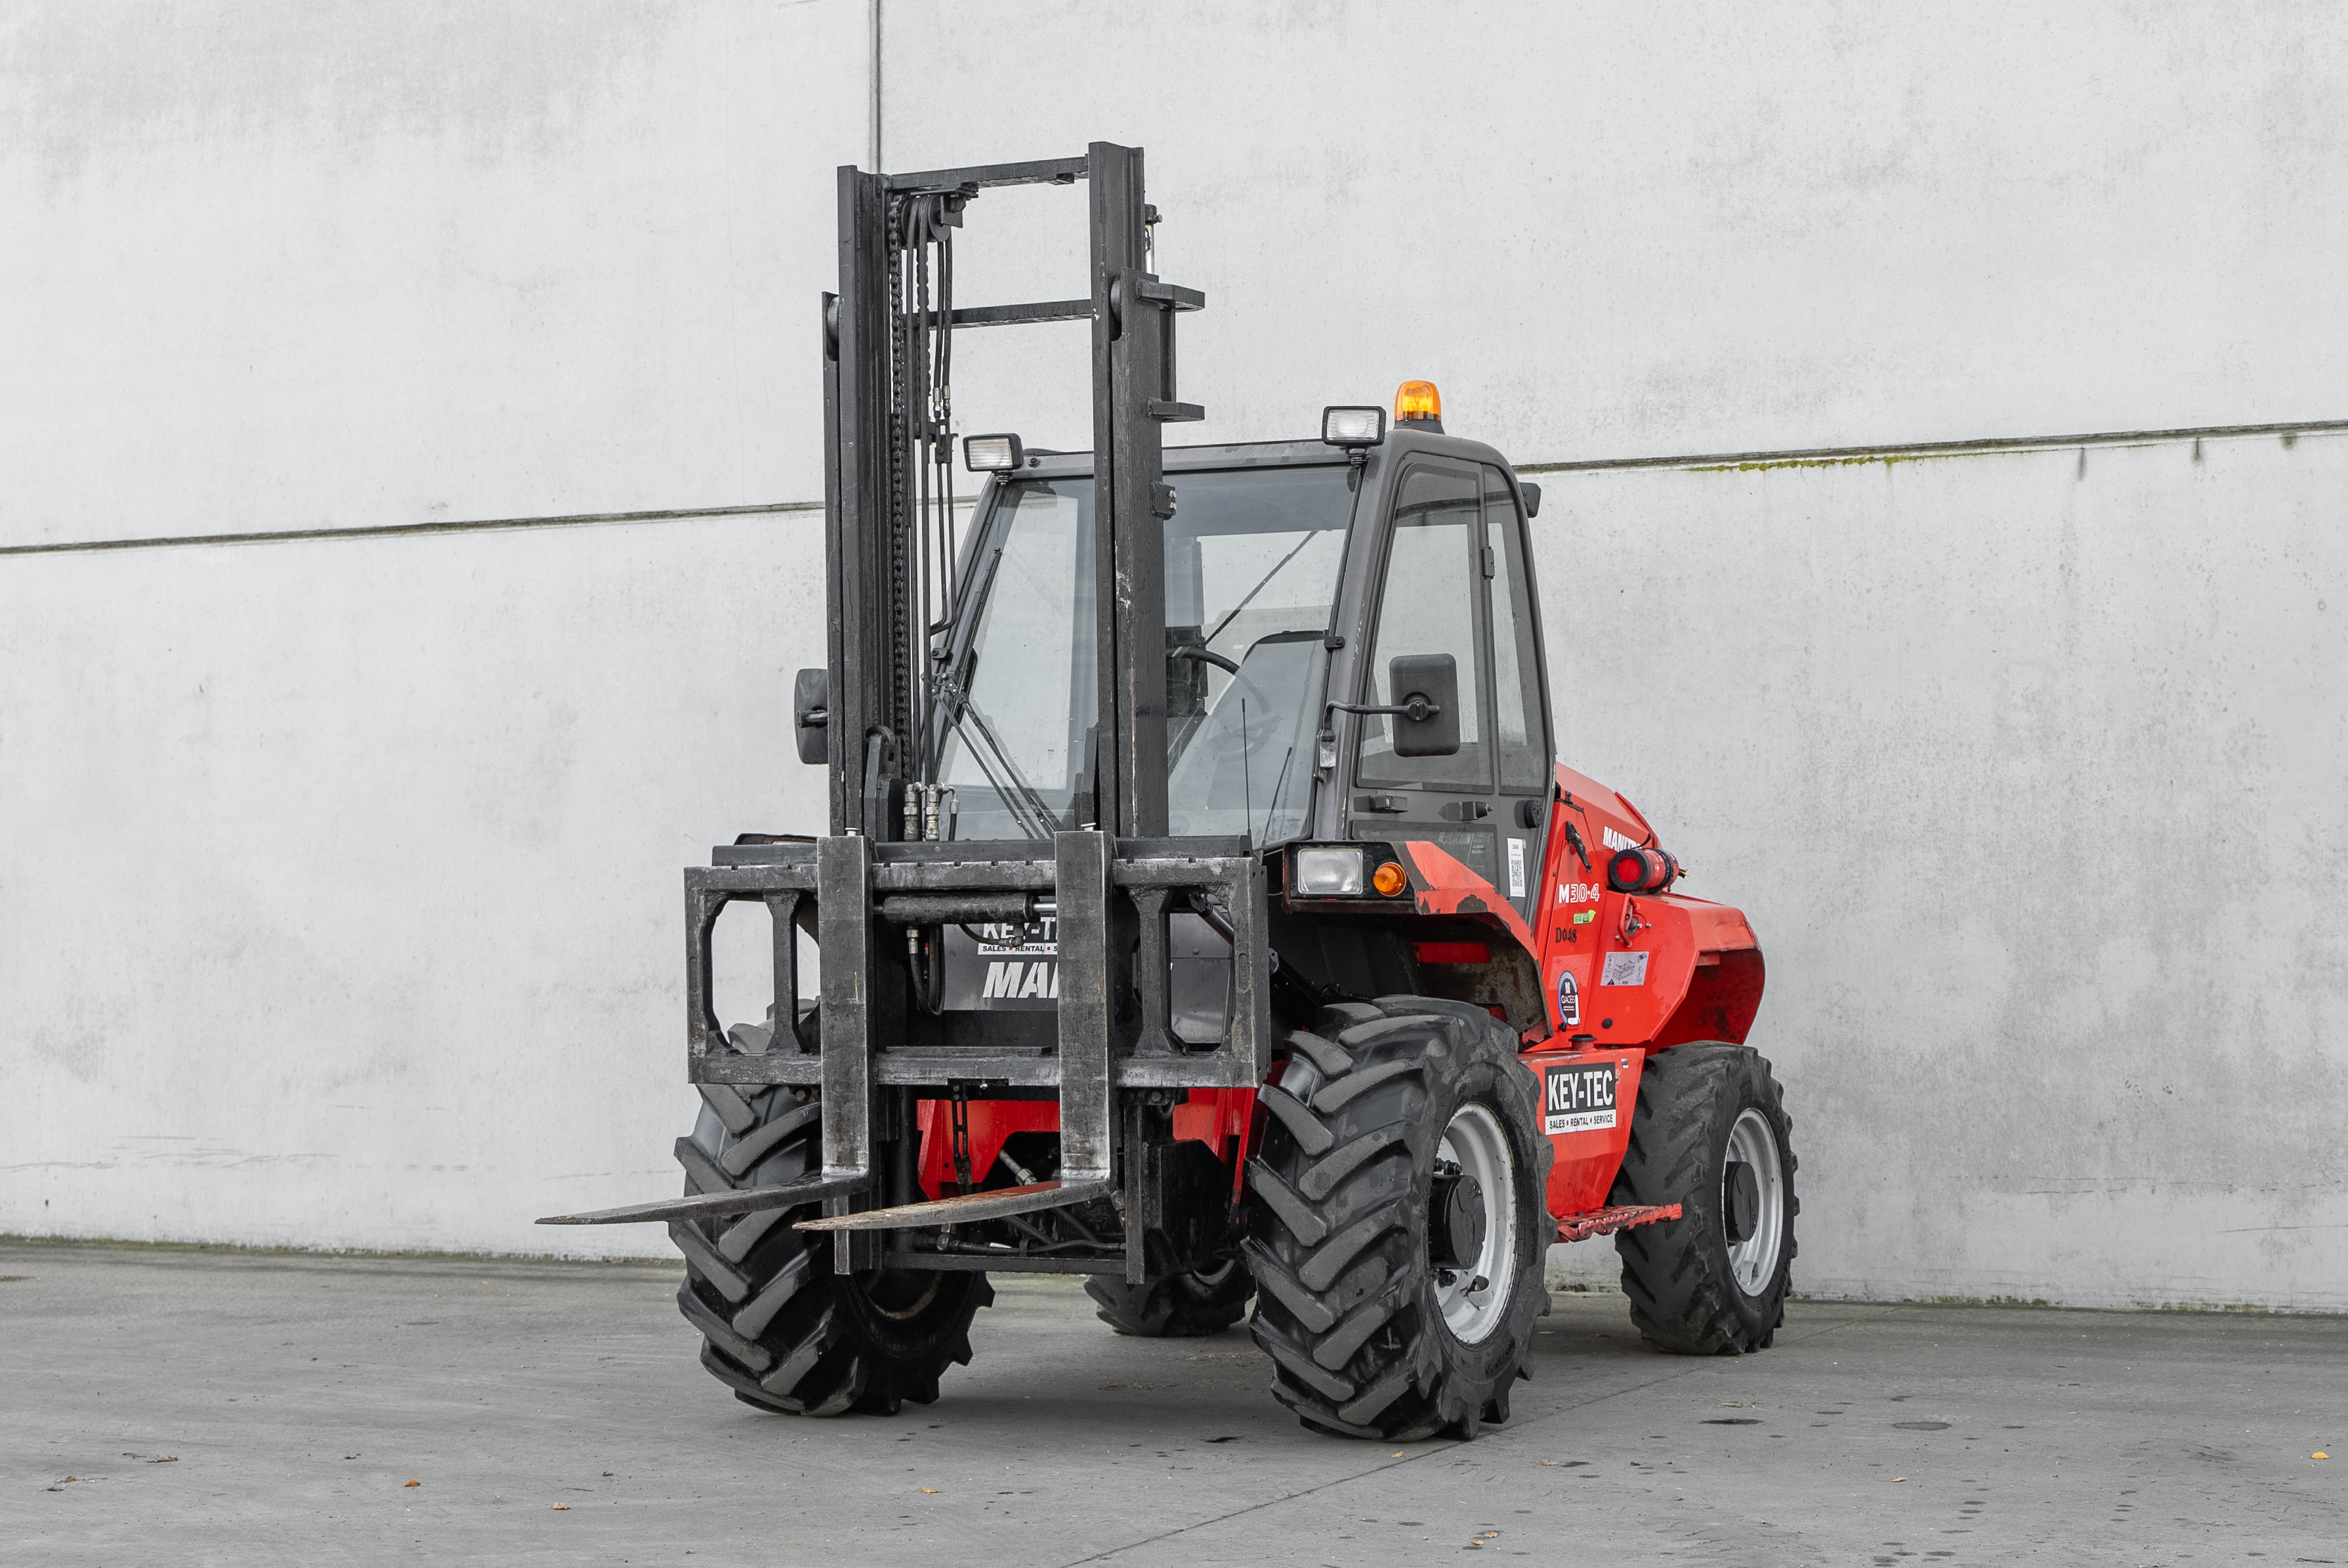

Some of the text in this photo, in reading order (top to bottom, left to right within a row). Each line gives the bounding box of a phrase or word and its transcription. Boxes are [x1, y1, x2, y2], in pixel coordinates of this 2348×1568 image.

[1603, 825, 1643, 853] MANIT
[1555, 926, 1577, 943] D048
[982, 962, 1058, 999] MA
[1548, 1069, 1613, 1111] KEY-TEC
[1549, 1114, 1613, 1130] SALES RENTAL SERVICE
